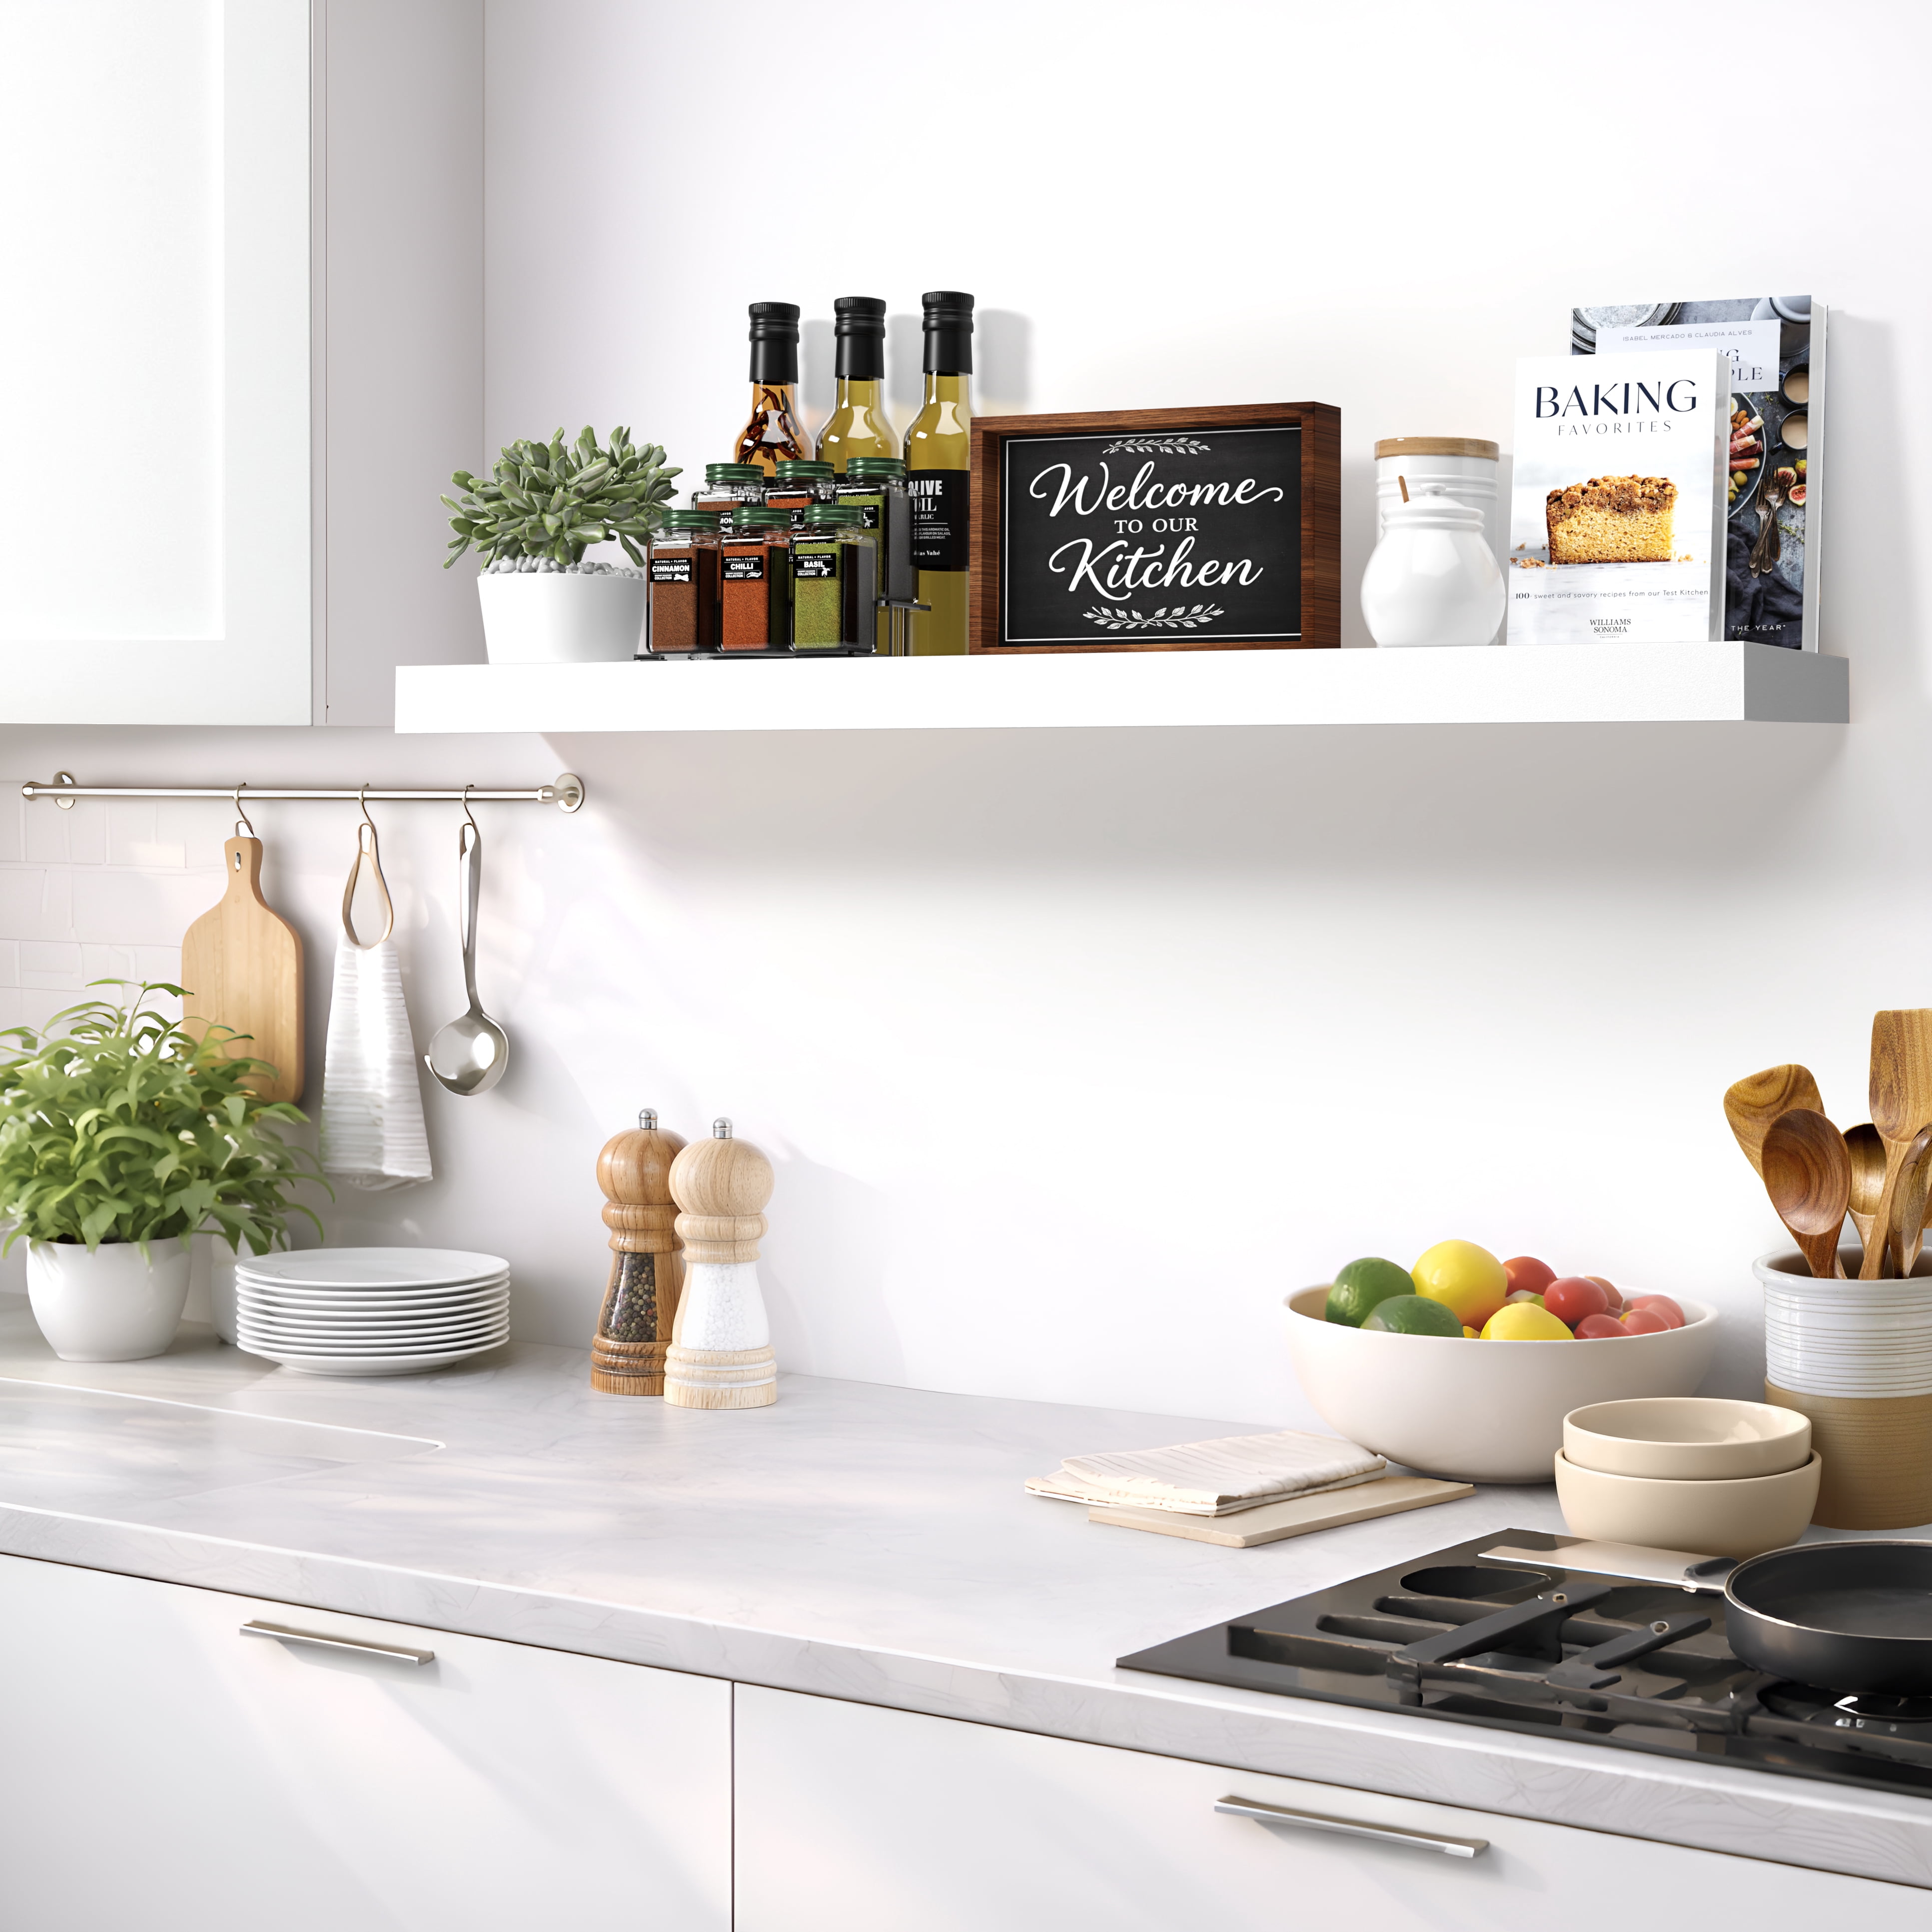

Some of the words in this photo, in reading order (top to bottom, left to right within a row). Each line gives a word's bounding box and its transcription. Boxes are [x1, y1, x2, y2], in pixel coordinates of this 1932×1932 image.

[1536, 379, 1697, 418] BAKING
[1558, 420, 1672, 436] FAVORITES
[1029, 461, 1283, 517] Welcome
[1114, 519, 1143, 534] TO
[1152, 518, 1199, 533] OUR
[1048, 536, 1263, 601] Kitchen
